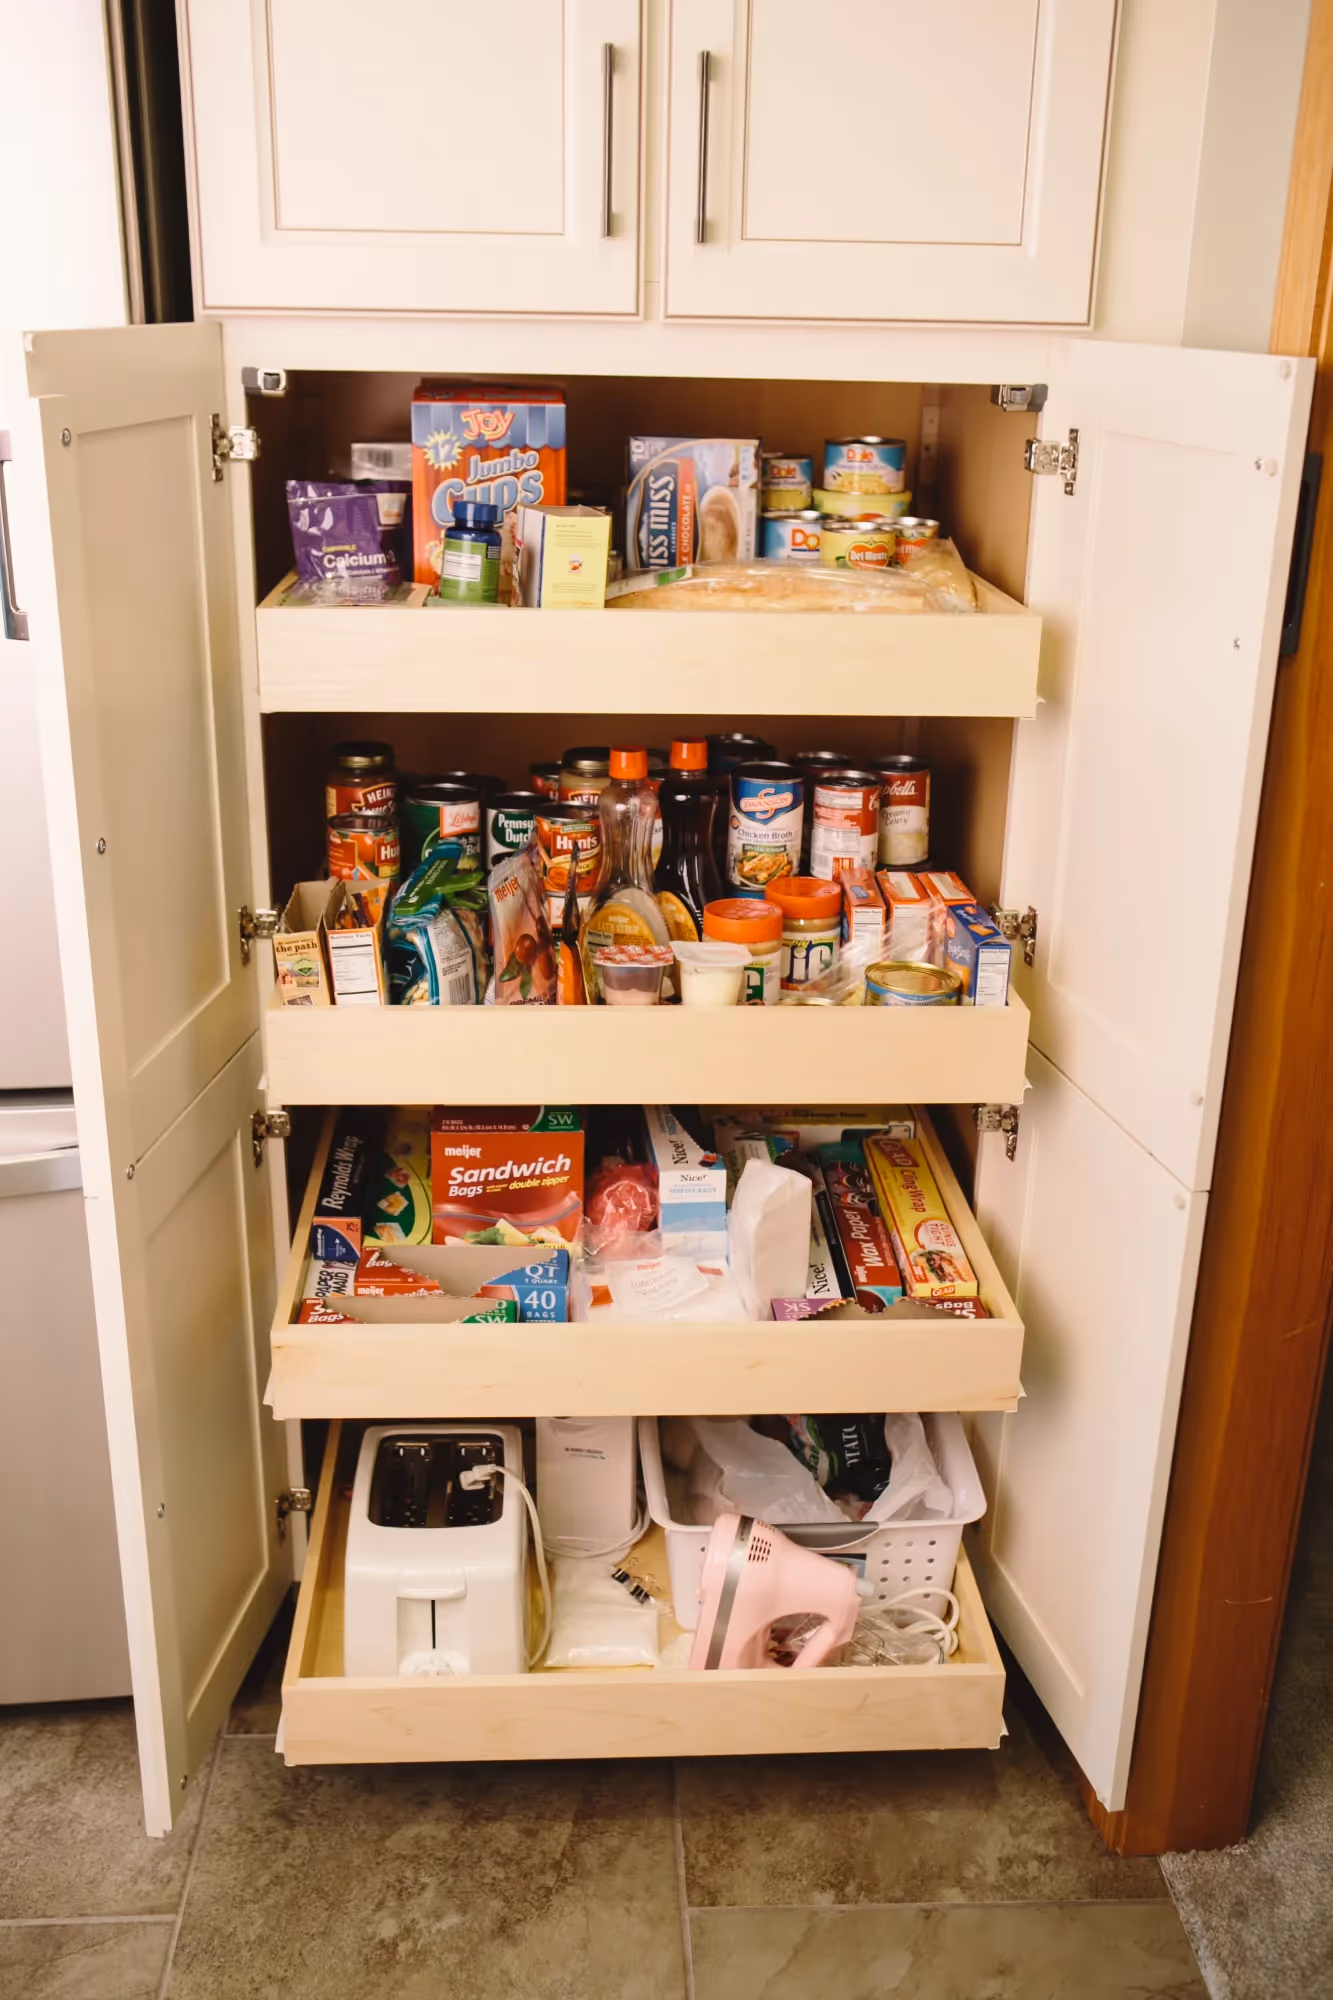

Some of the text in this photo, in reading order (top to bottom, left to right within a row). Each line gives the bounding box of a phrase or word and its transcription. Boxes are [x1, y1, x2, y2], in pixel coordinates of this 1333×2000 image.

[846, 448, 874, 461] Dole
[466, 448, 539, 483] Jumbo
[770, 465, 796, 477] Dole
[431, 470, 544, 527] Cups
[791, 528, 821, 550] Do
[649, 534, 669, 568] ISS
[323, 553, 387, 568] Calcium
[366, 788, 395, 804] HEIN
[498, 814, 537, 830] Pennsy
[738, 829, 793, 840] Chicken Broth
[494, 876, 520, 903] meijer
[276, 944, 293, 953] the
[295, 941, 318, 954] path
[548, 1114, 573, 1126] SW
[445, 1144, 482, 1158] meijer
[669, 1140, 689, 1165] Nice!
[448, 1153, 572, 1185] Sandwich
[321, 1161, 352, 1210] Reynolds
[509, 1178, 541, 1190] double
[540, 1175, 570, 1187] zipper
[680, 1174, 708, 1182] Nice!
[448, 1184, 484, 1198] Bags
[901, 1169, 927, 1213] Cling Wrap
[844, 1209, 885, 1267] Wax Paper
[928, 1223, 946, 1247] TIGHT
[524, 1264, 560, 1279] QT
[809, 1262, 831, 1295] Nice!
[315, 1270, 334, 1298] PAPER
[332, 1271, 349, 1295] MAID
[357, 1285, 384, 1297] meijer
[932, 1286, 955, 1297] GLAD
[524, 1290, 556, 1310] 40
[936, 1301, 974, 1310] Bags
[308, 1313, 345, 1324] Bags
